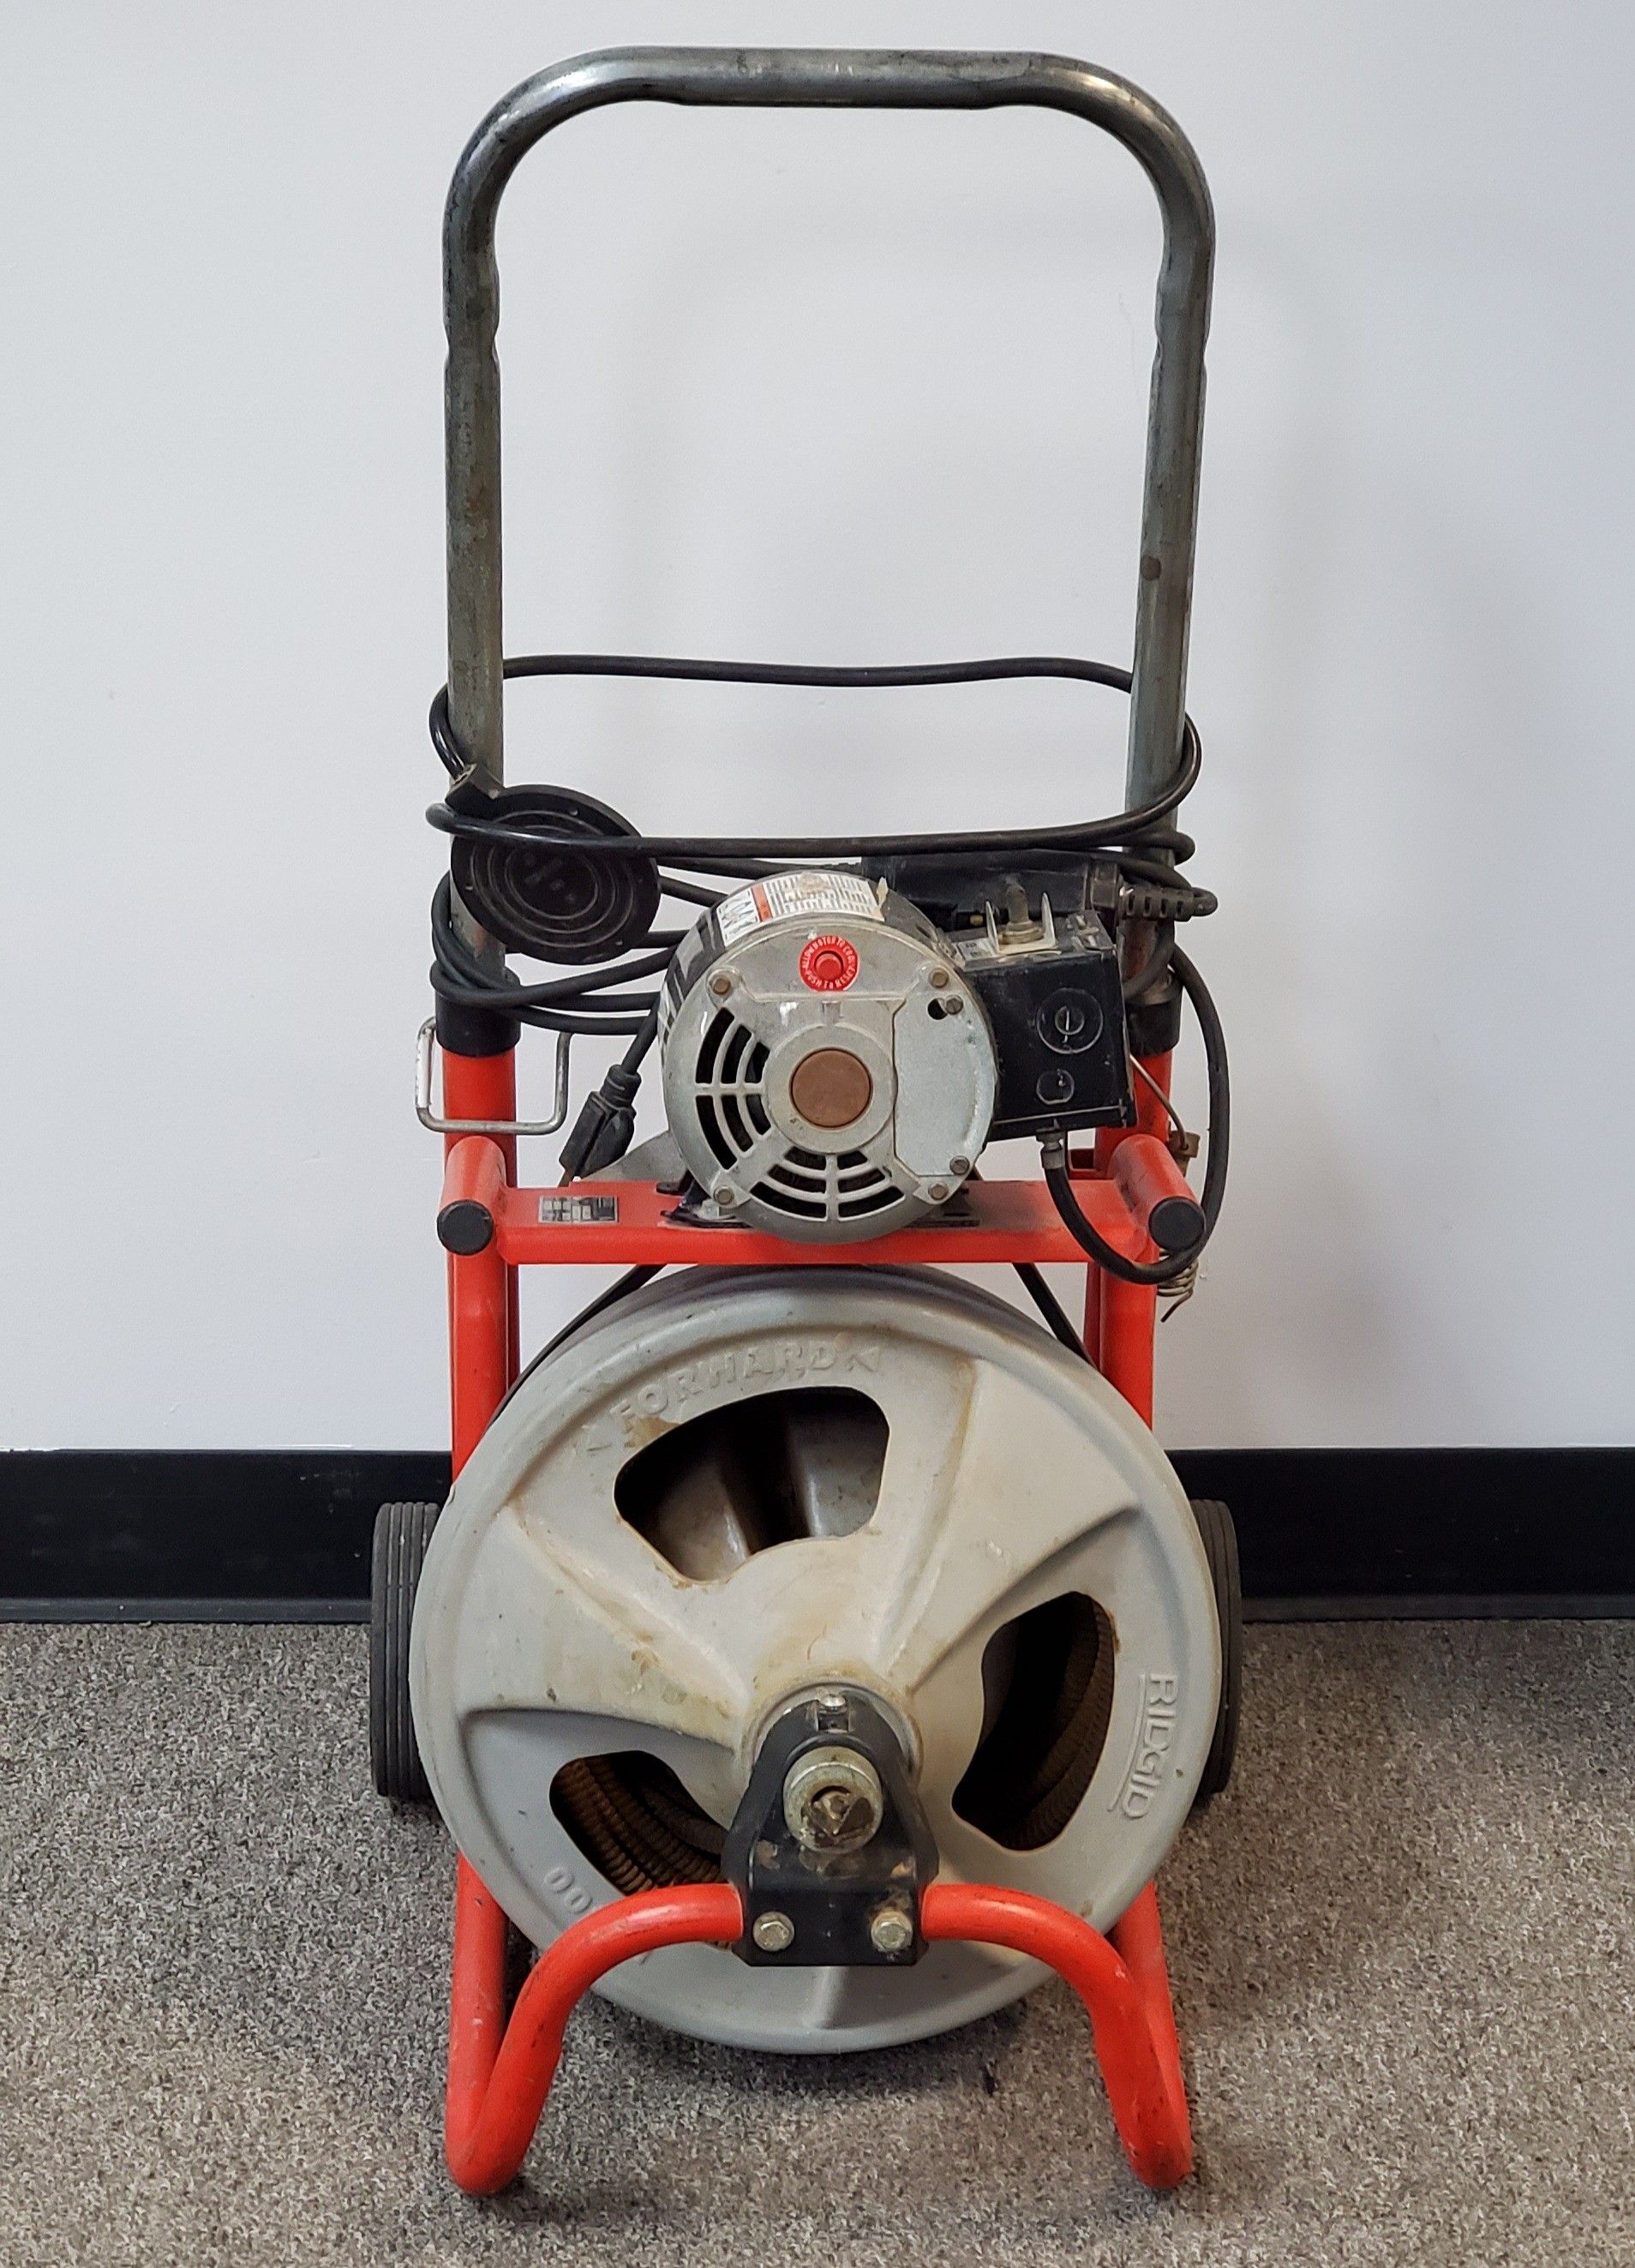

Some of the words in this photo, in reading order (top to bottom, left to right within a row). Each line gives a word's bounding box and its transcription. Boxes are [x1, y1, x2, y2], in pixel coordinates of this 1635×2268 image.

[812, 935, 836, 950] MOTOR
[835, 935, 846, 948] TO
[805, 969, 823, 987] PUSH
[823, 980, 834, 989] TO
[835, 965, 856, 987] RESET
[1121, 1673, 1179, 1820] RIDGID
